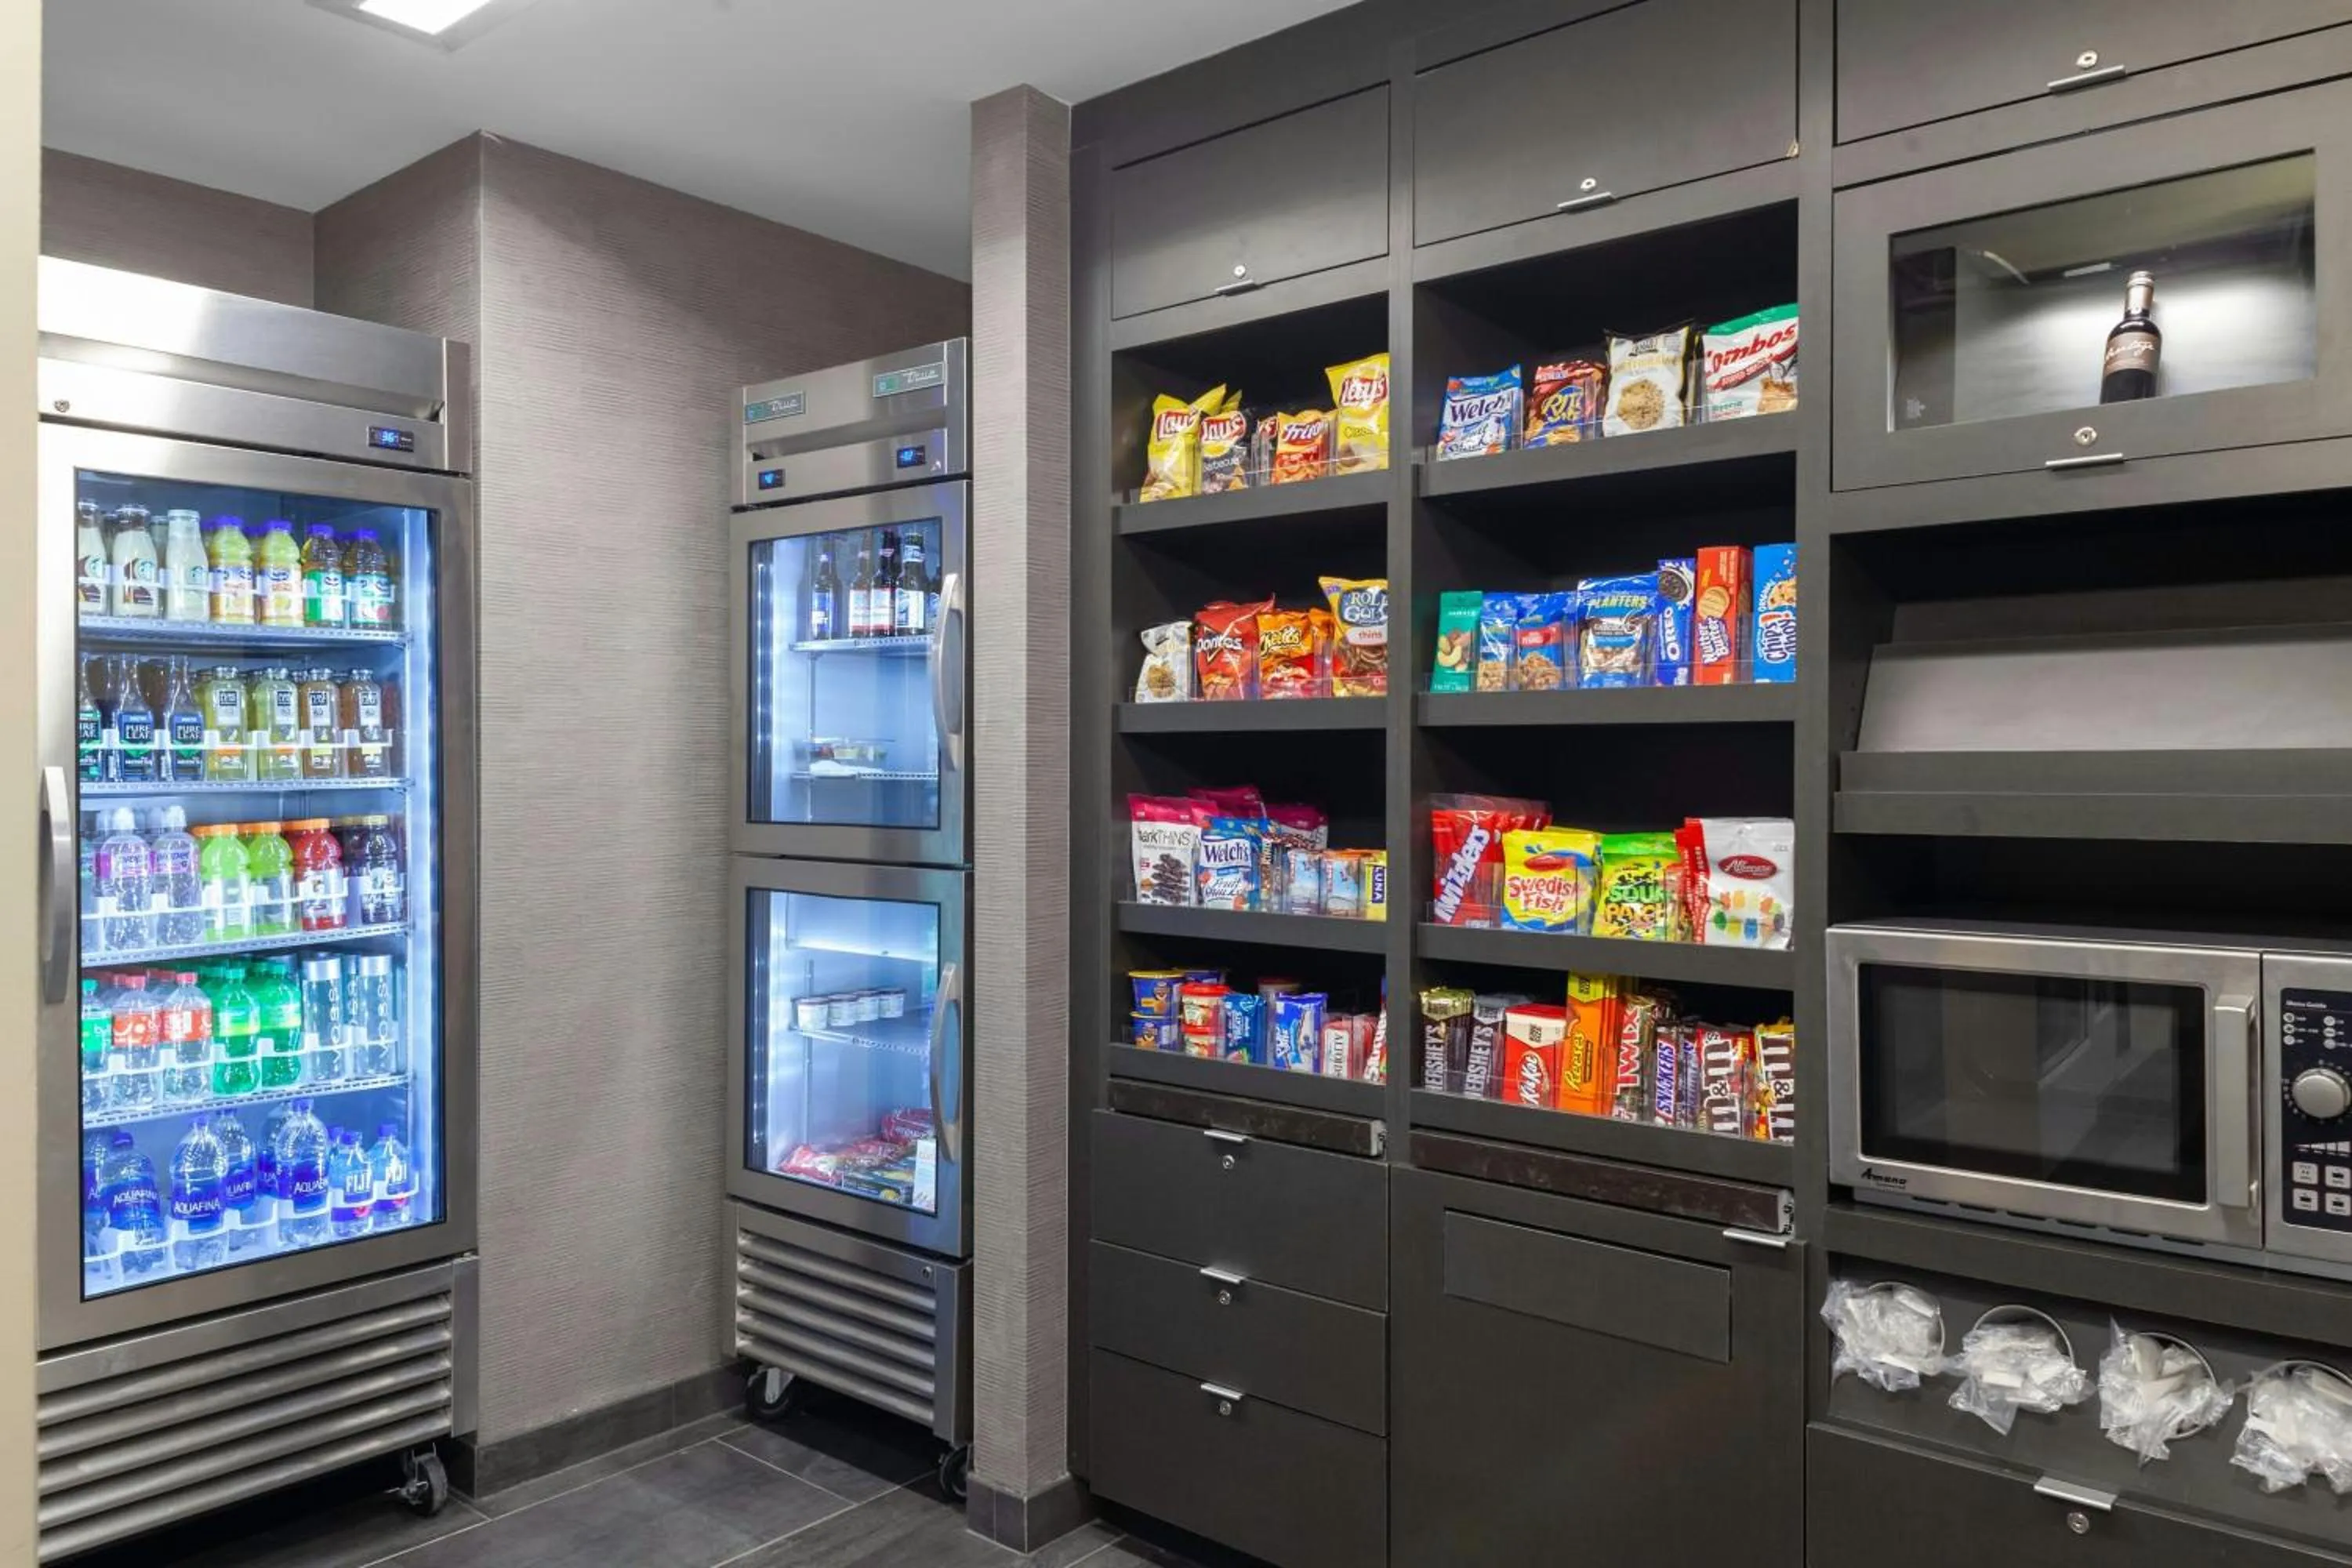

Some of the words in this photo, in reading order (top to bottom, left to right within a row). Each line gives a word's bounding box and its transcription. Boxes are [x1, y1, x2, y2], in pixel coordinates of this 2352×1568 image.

[1663, 606, 1681, 661] OREO
[1203, 841, 1249, 863] Welch's
[1374, 866, 1385, 902] LUNA
[1523, 892, 1565, 913] Fish
[1616, 1004, 1642, 1095] TWIX
[1657, 1041, 1676, 1115] SNICKERS
[173, 1197, 221, 1214] AQUAFINA
